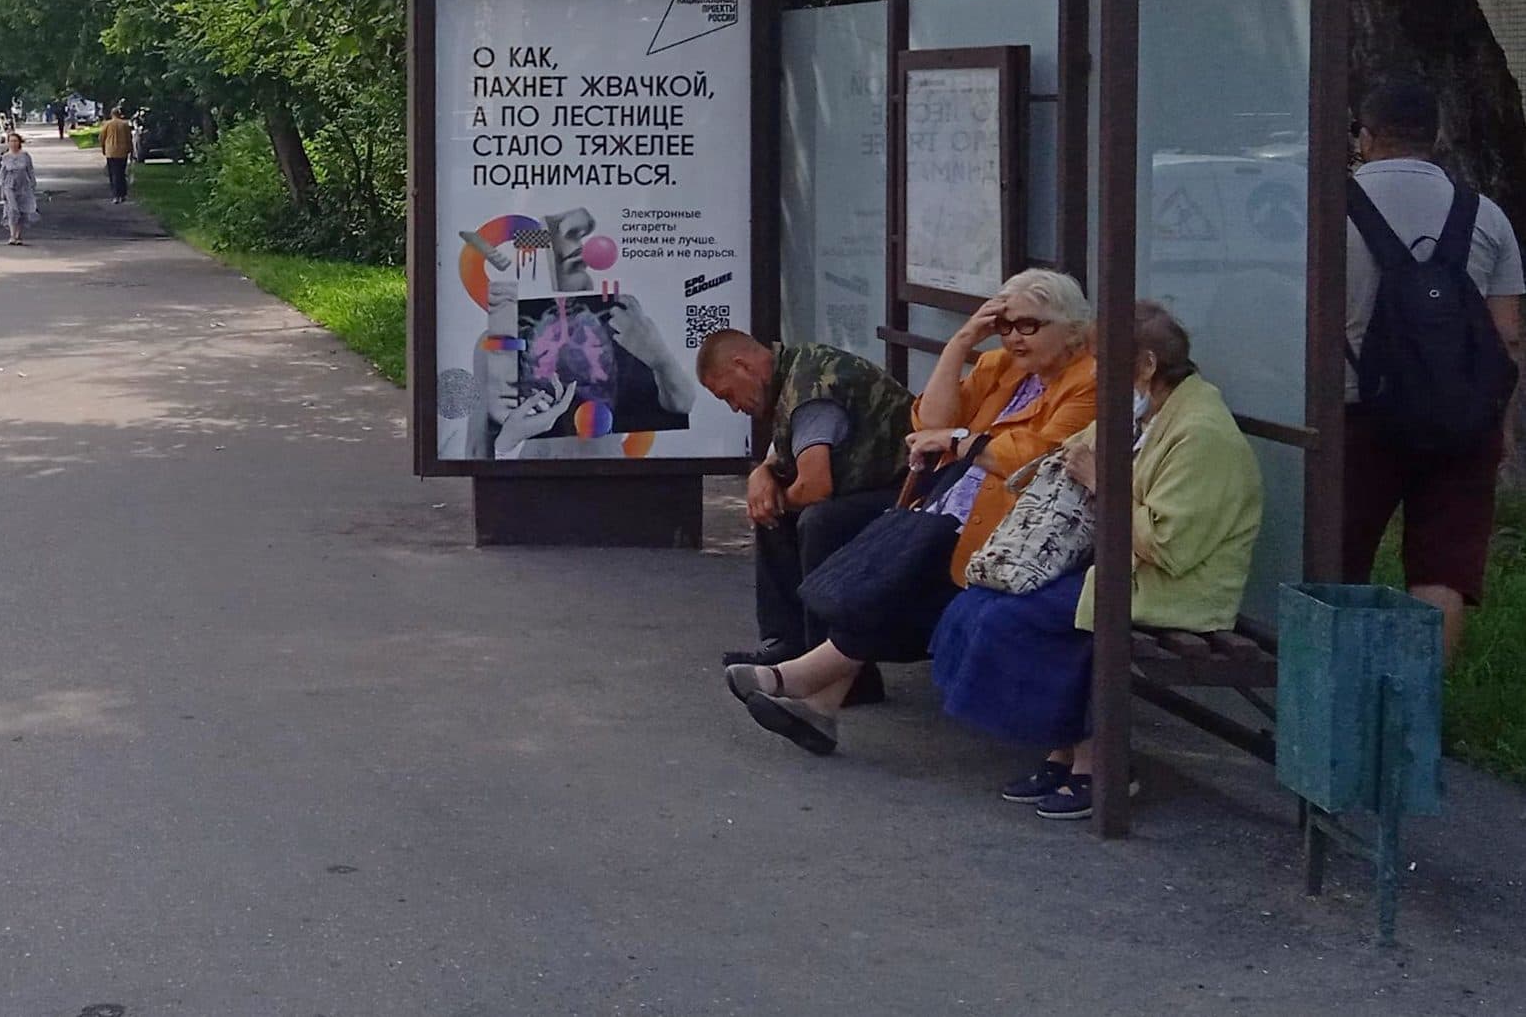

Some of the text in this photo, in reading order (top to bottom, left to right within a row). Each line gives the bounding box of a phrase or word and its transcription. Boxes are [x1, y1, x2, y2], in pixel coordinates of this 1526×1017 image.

[702, 4, 736, 13] ПРОЕКТЫ
[474, 46, 559, 71] О КАК,
[473, 70, 715, 100] ПАХНЕТ ЖВАЧКОЙ,
[473, 105, 684, 130] А ПО ЛЕСТНИЦЕ
[473, 135, 694, 157] СТАЛО ТЯЖЕЛЕЕ
[473, 164, 677, 190] ПОДНИМАТЬСЯ.
[622, 208, 702, 220] Электронные
[622, 223, 677, 233] сигареты
[622, 236, 716, 247] ничем не лучше.
[622, 247, 737, 259] Бросай и не парься.
